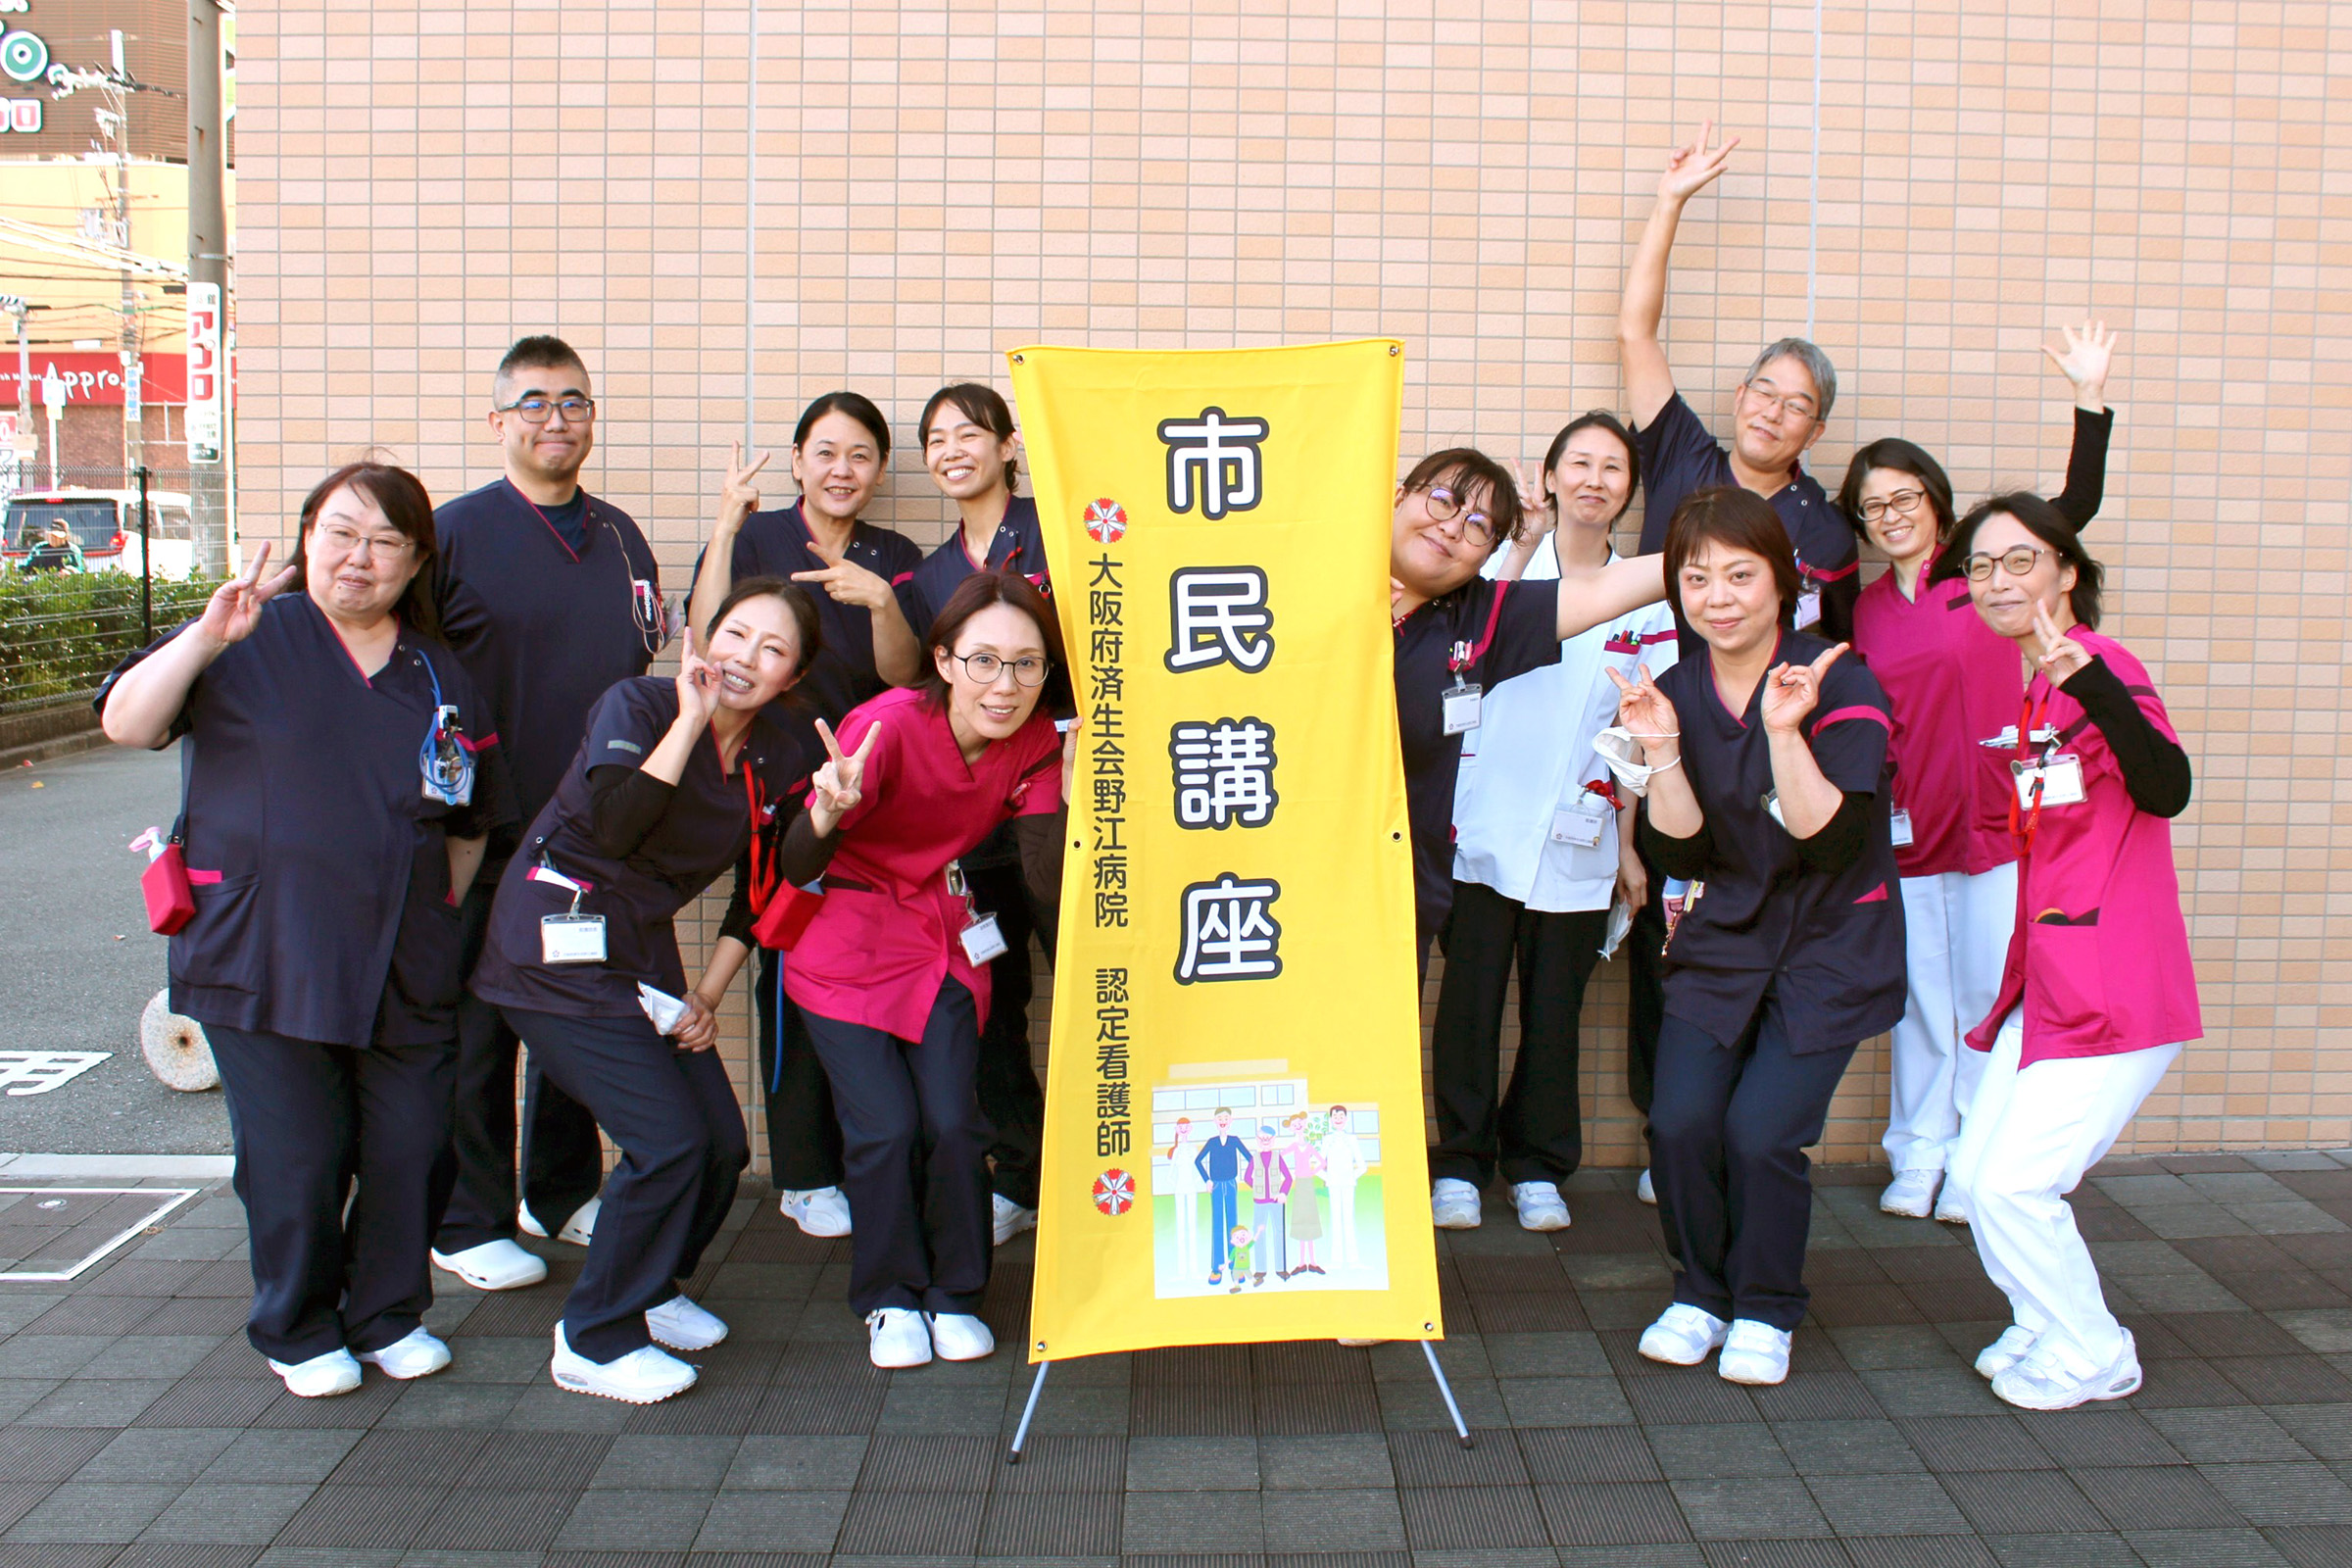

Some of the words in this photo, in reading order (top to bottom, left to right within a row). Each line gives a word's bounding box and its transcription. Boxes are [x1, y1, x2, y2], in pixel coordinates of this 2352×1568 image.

[1089, 553, 1128, 928] 大阪府済生会野江病院
[1157, 407, 1282, 985] 市民講座
[1096, 967, 1131, 1157] 認定看護師
